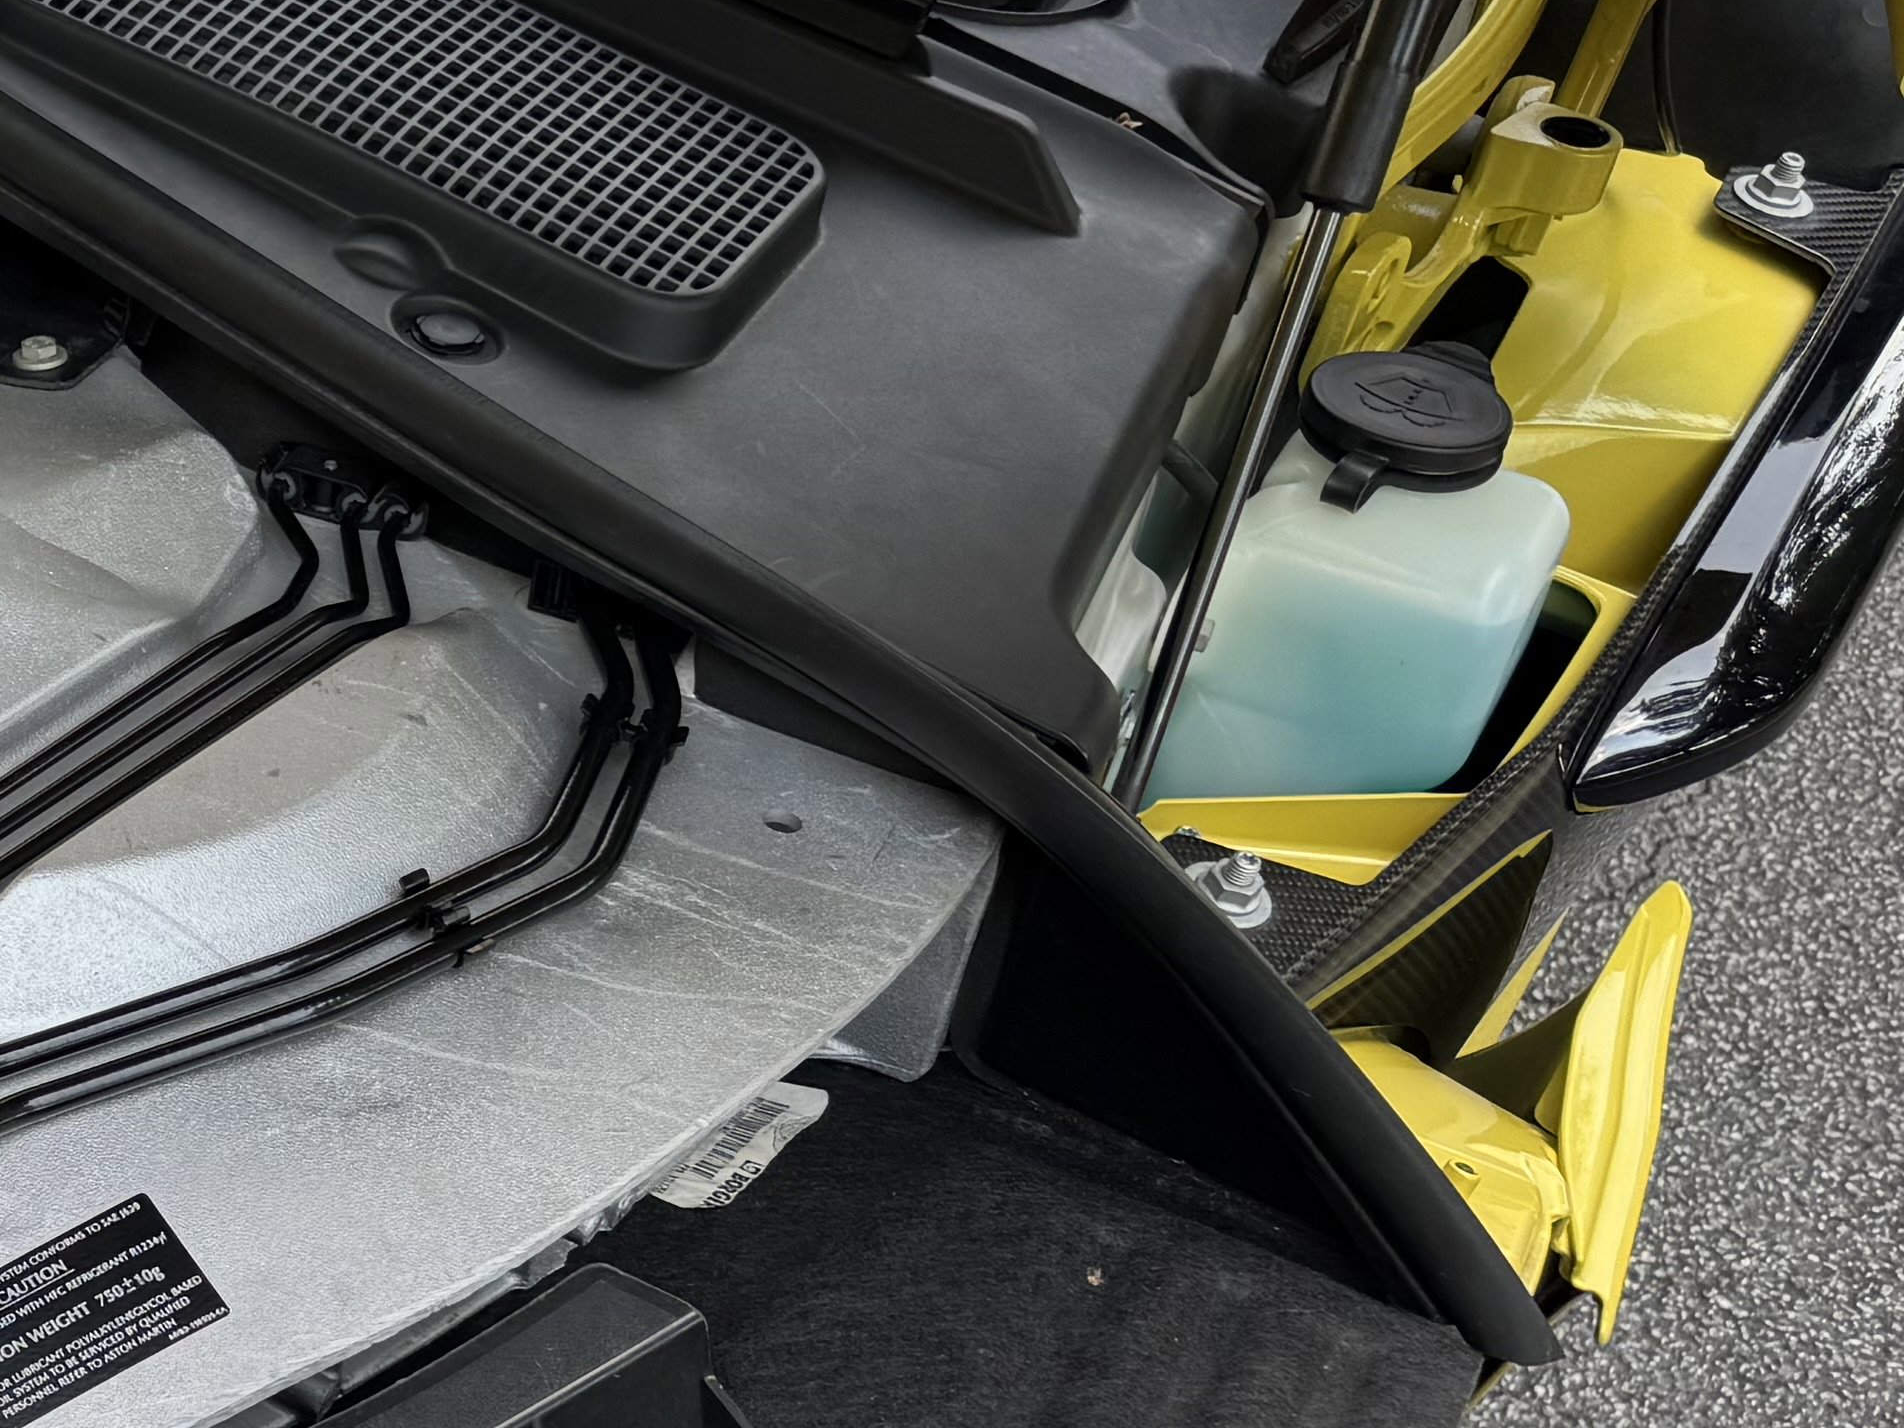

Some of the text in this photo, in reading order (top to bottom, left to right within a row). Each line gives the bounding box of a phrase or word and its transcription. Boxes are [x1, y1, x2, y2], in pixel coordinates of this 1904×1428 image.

[15, 1297, 45, 1317] WITH
[65, 1250, 129, 1291] REFRIGERANT
[28, 1233, 86, 1266] CONFORMS
[84, 1222, 101, 1235] TO
[11, 1347, 65, 1384] LUBRICANT
[170, 1275, 203, 1297] BASED
[12, 1371, 51, 1398] SYSTEM
[48, 1363, 66, 1377] TO
[64, 1355, 80, 1369] BE
[78, 1331, 125, 1362] SERVICED
[124, 1323, 138, 1337] BY
[138, 1296, 191, 1328] QUALIFIED
[25, 1301, 91, 1343] WEIGHT
[1, 1383, 60, 1419] PERSONNEL
[57, 1366, 89, 1388] REFER
[86, 1358, 103, 1371] TO
[103, 1338, 138, 1364] ASTON
[136, 1317, 178, 1345] MARTIN
